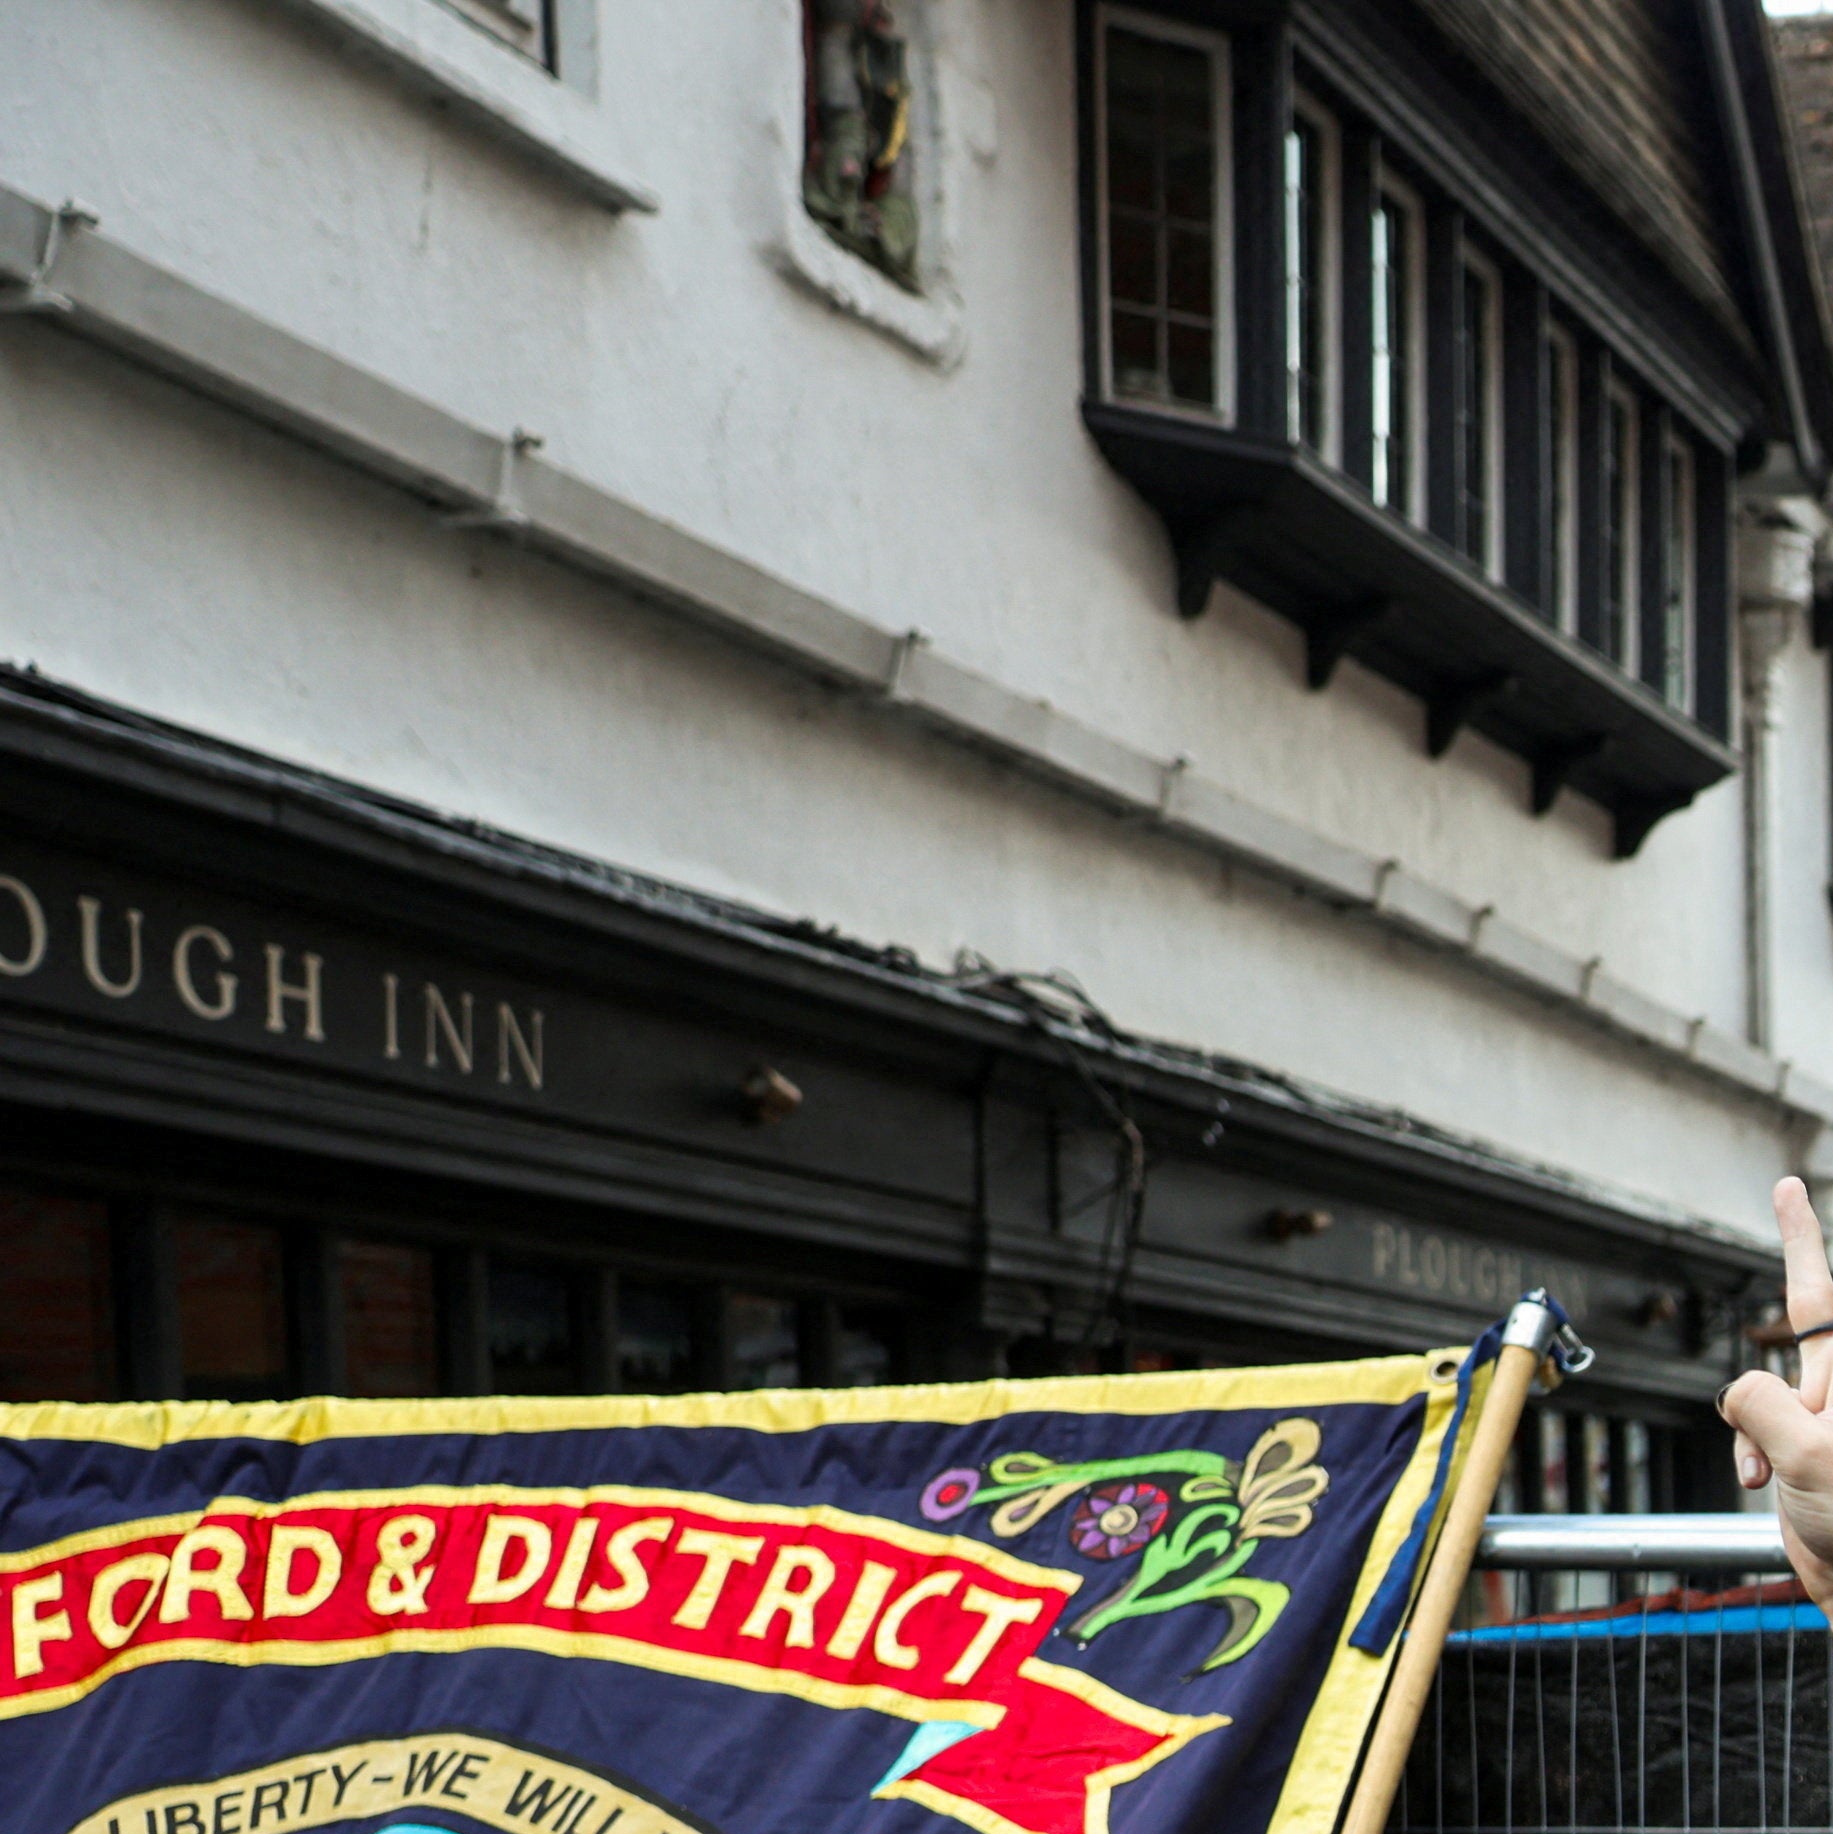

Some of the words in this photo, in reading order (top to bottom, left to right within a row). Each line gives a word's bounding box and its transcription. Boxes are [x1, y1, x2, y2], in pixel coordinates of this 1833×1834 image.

[382, 972, 546, 1091] INN
[1372, 1222, 1523, 1299] PLOUGH
[12, 1523, 343, 1680] FORD
[366, 1513, 434, 1615] &
[467, 1513, 1042, 1686] DISTRICT
